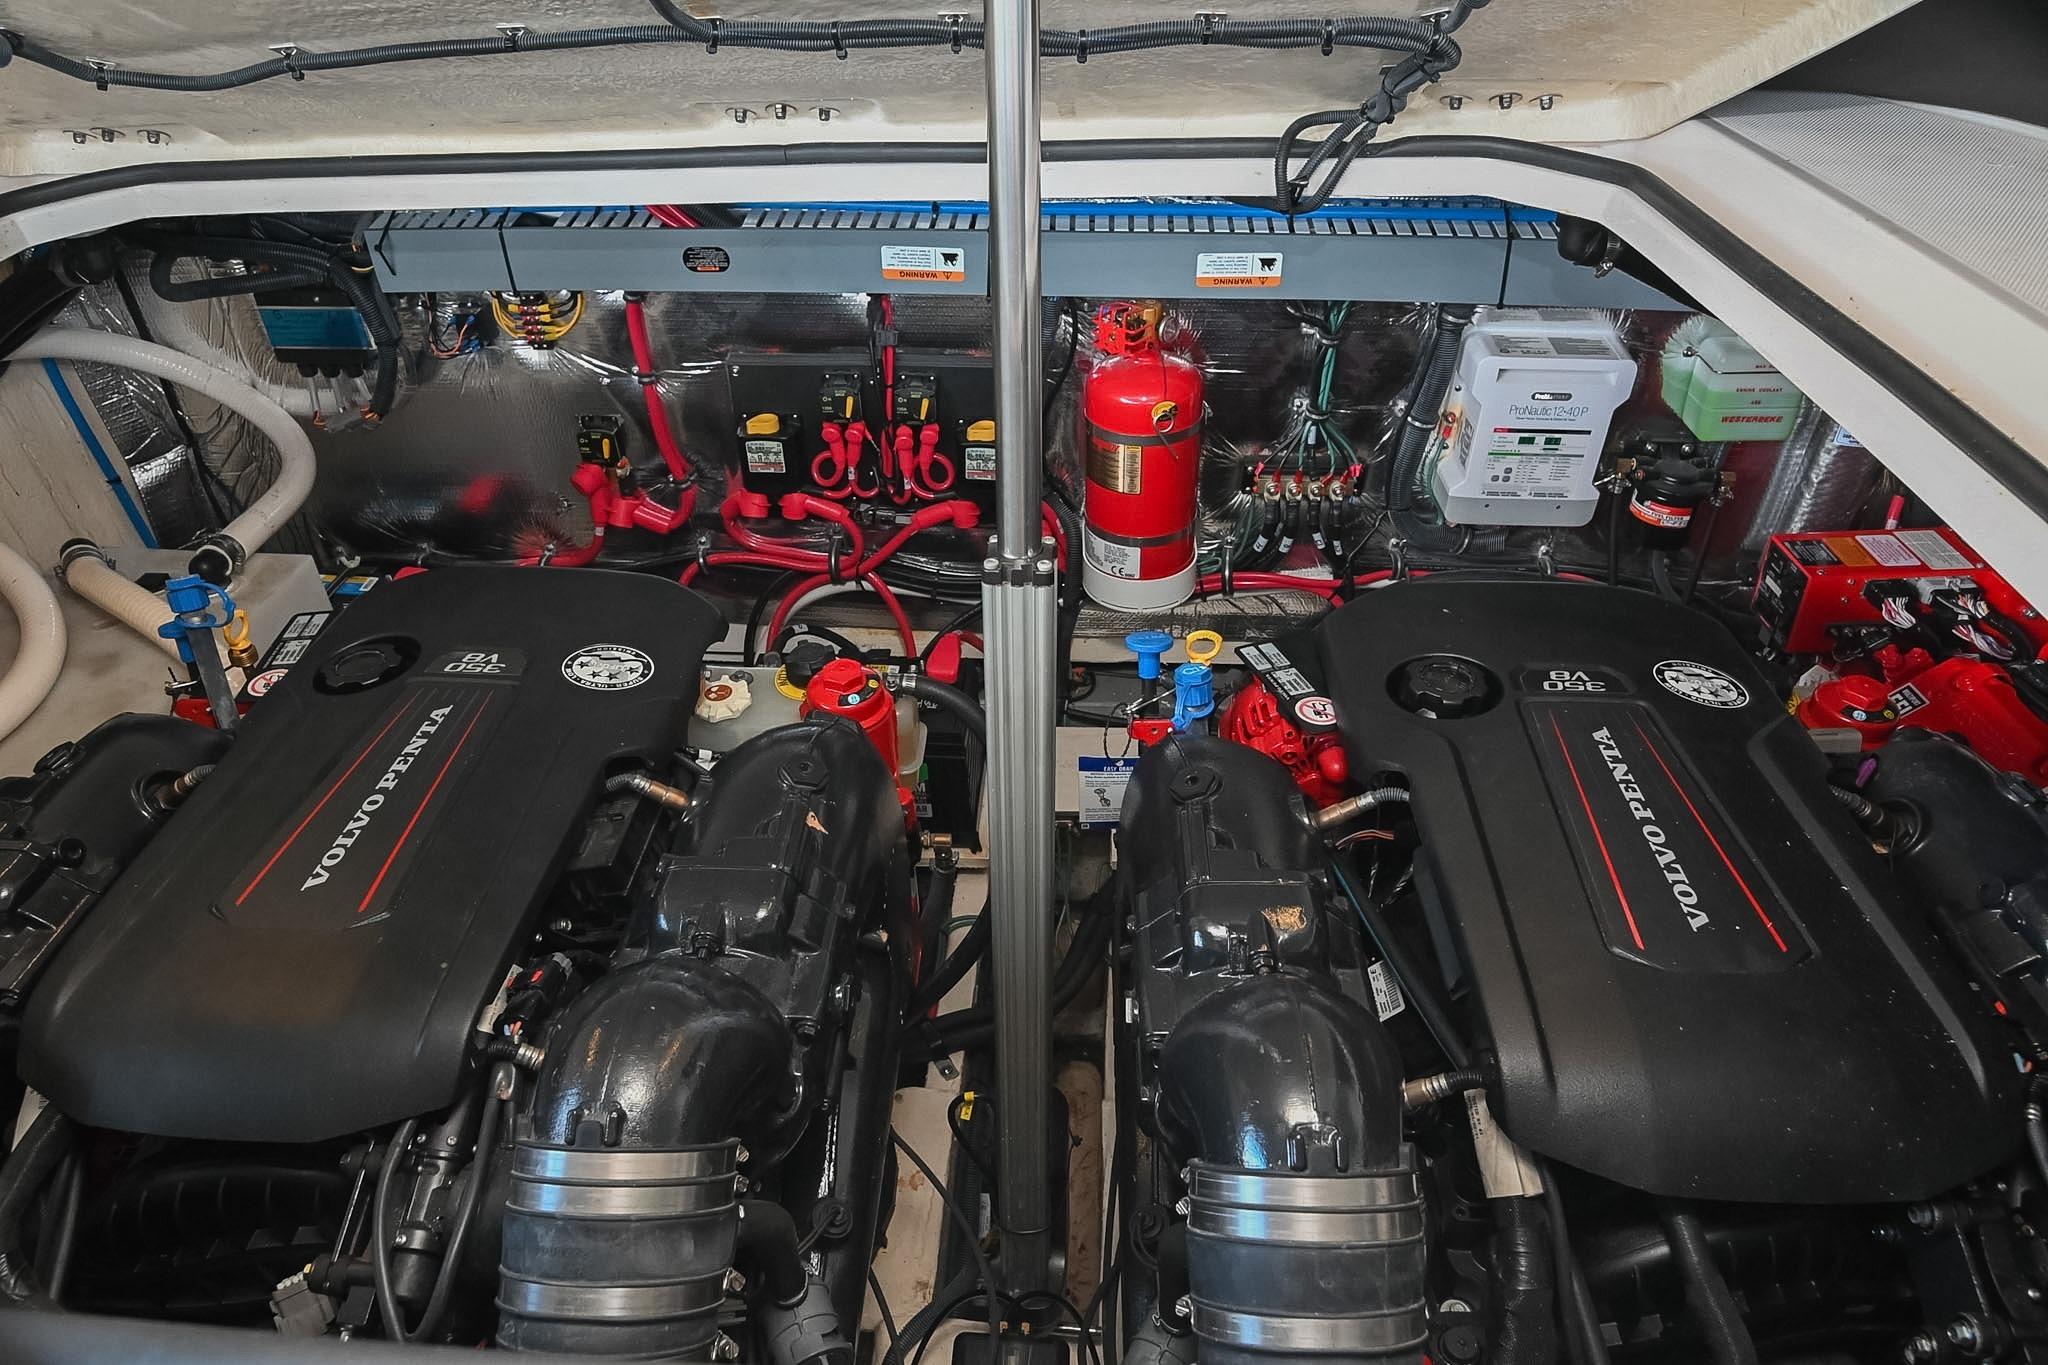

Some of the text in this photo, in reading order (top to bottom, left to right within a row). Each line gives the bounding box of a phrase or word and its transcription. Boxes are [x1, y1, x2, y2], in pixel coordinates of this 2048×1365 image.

[899, 270, 938, 280] WARNING
[1213, 278, 1253, 286] WARNING
[1508, 404, 1553, 416] ProNautic
[1721, 415, 1784, 424] WESTERBEKE
[461, 652, 499, 664] V8
[443, 662, 506, 674] 350
[615, 675, 644, 688] SUPER
[1549, 670, 1590, 681] V8
[1543, 680, 1606, 692] 350
[299, 703, 454, 893] VOLVO PENTA
[1590, 725, 1711, 934] VOLVO PENTA
